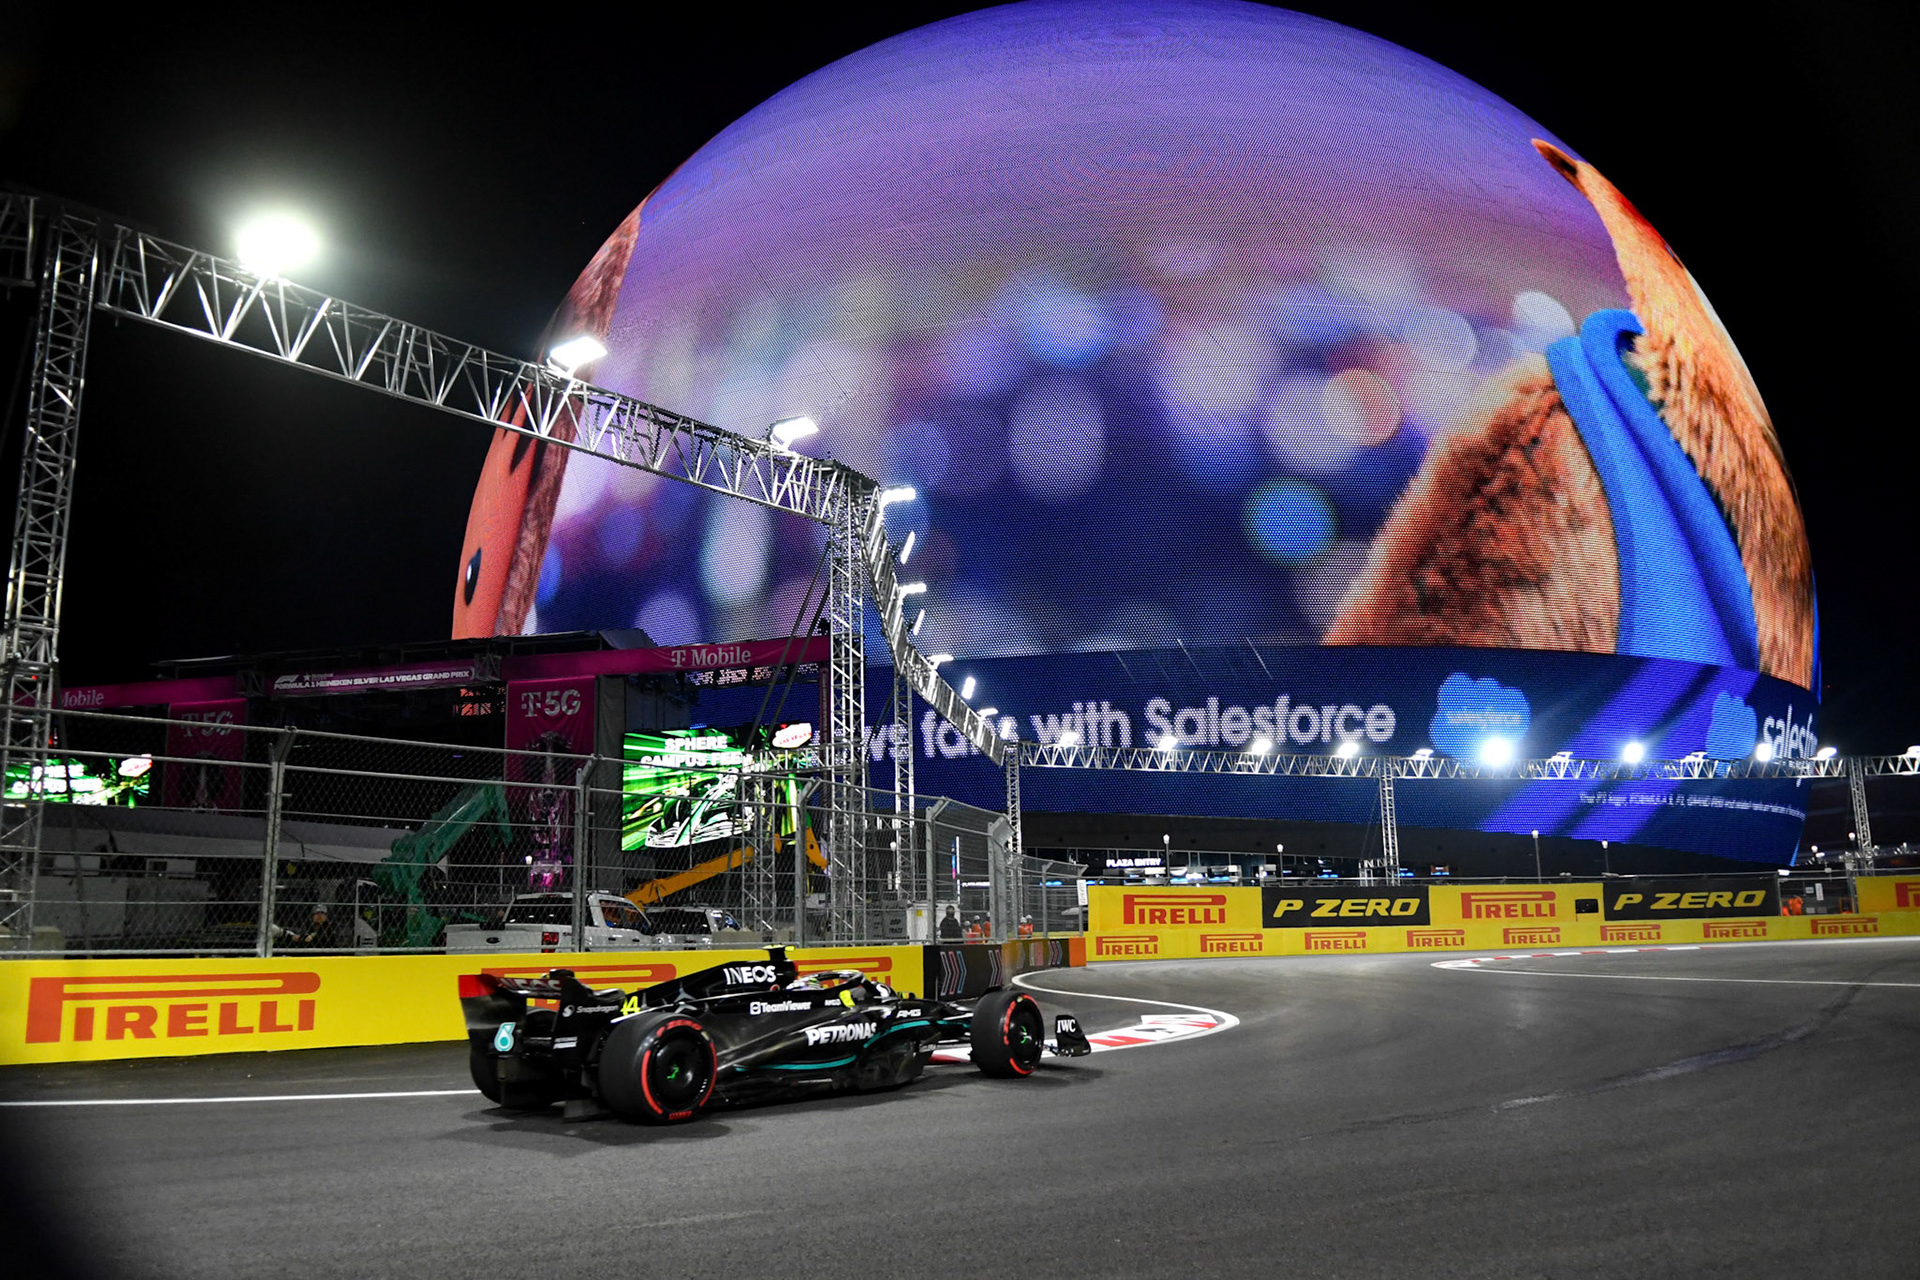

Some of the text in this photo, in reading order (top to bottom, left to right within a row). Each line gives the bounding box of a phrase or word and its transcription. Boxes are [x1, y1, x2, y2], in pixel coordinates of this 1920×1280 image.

[691, 647, 752, 667] Mobile
[354, 675, 379, 685] SILVER
[380, 674, 395, 683] LAS
[396, 672, 422, 682] VEGAS
[423, 671, 451, 680] GRAND
[451, 669, 470, 679] PRIX
[1030, 701, 1132, 750] with
[1143, 693, 1397, 750] Salesforce
[664, 735, 728, 752] SPHERE
[1106, 857, 1162, 868] PLAZA ENTRY
[1122, 894, 1227, 925] PIRELLI
[1272, 897, 1421, 918] P ZERO
[1461, 890, 1557, 919] PIRELLI
[1613, 890, 1766, 911] P ZERO
[1503, 926, 1561, 945] PIRELLI
[1600, 924, 1661, 942] PIRELLI
[1702, 920, 1767, 938] PIRELLI
[1811, 918, 1878, 935] PIRELLI
[1095, 935, 1158, 955] PIRELLI
[1200, 933, 1263, 953] PIRELLI
[1304, 931, 1367, 950] PIRELLI
[1406, 929, 1465, 948] PIRELLI
[723, 965, 778, 985] INEOS
[25, 971, 321, 1044] PIRELLI
[575, 1004, 619, 1016] Snapdragon
[761, 1000, 812, 1014] TeamViewer
[896, 1008, 922, 1019] AMG
[804, 1021, 877, 1047] PETRONAS
[1056, 1019, 1077, 1034] IWC
